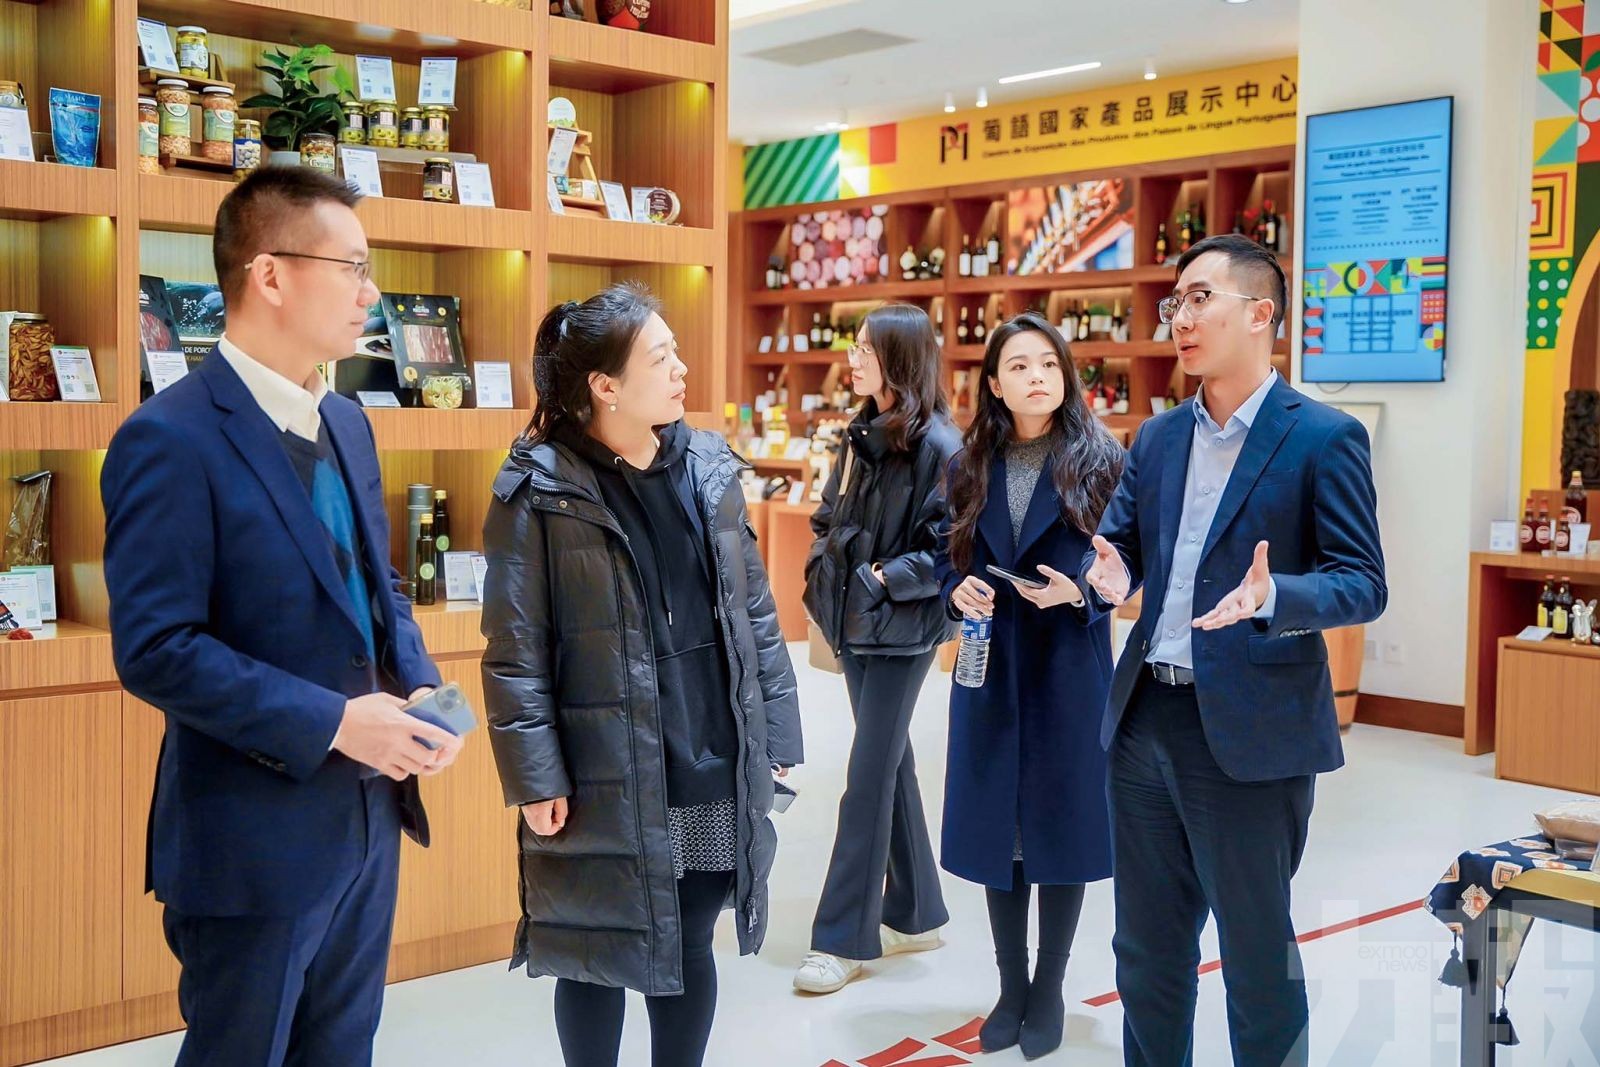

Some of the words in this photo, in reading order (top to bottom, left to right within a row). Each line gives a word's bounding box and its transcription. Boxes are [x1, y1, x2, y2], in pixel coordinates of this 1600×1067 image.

[984, 74, 1297, 142] 葡語國家產品展示中心
[184, 346, 192, 354] DE
